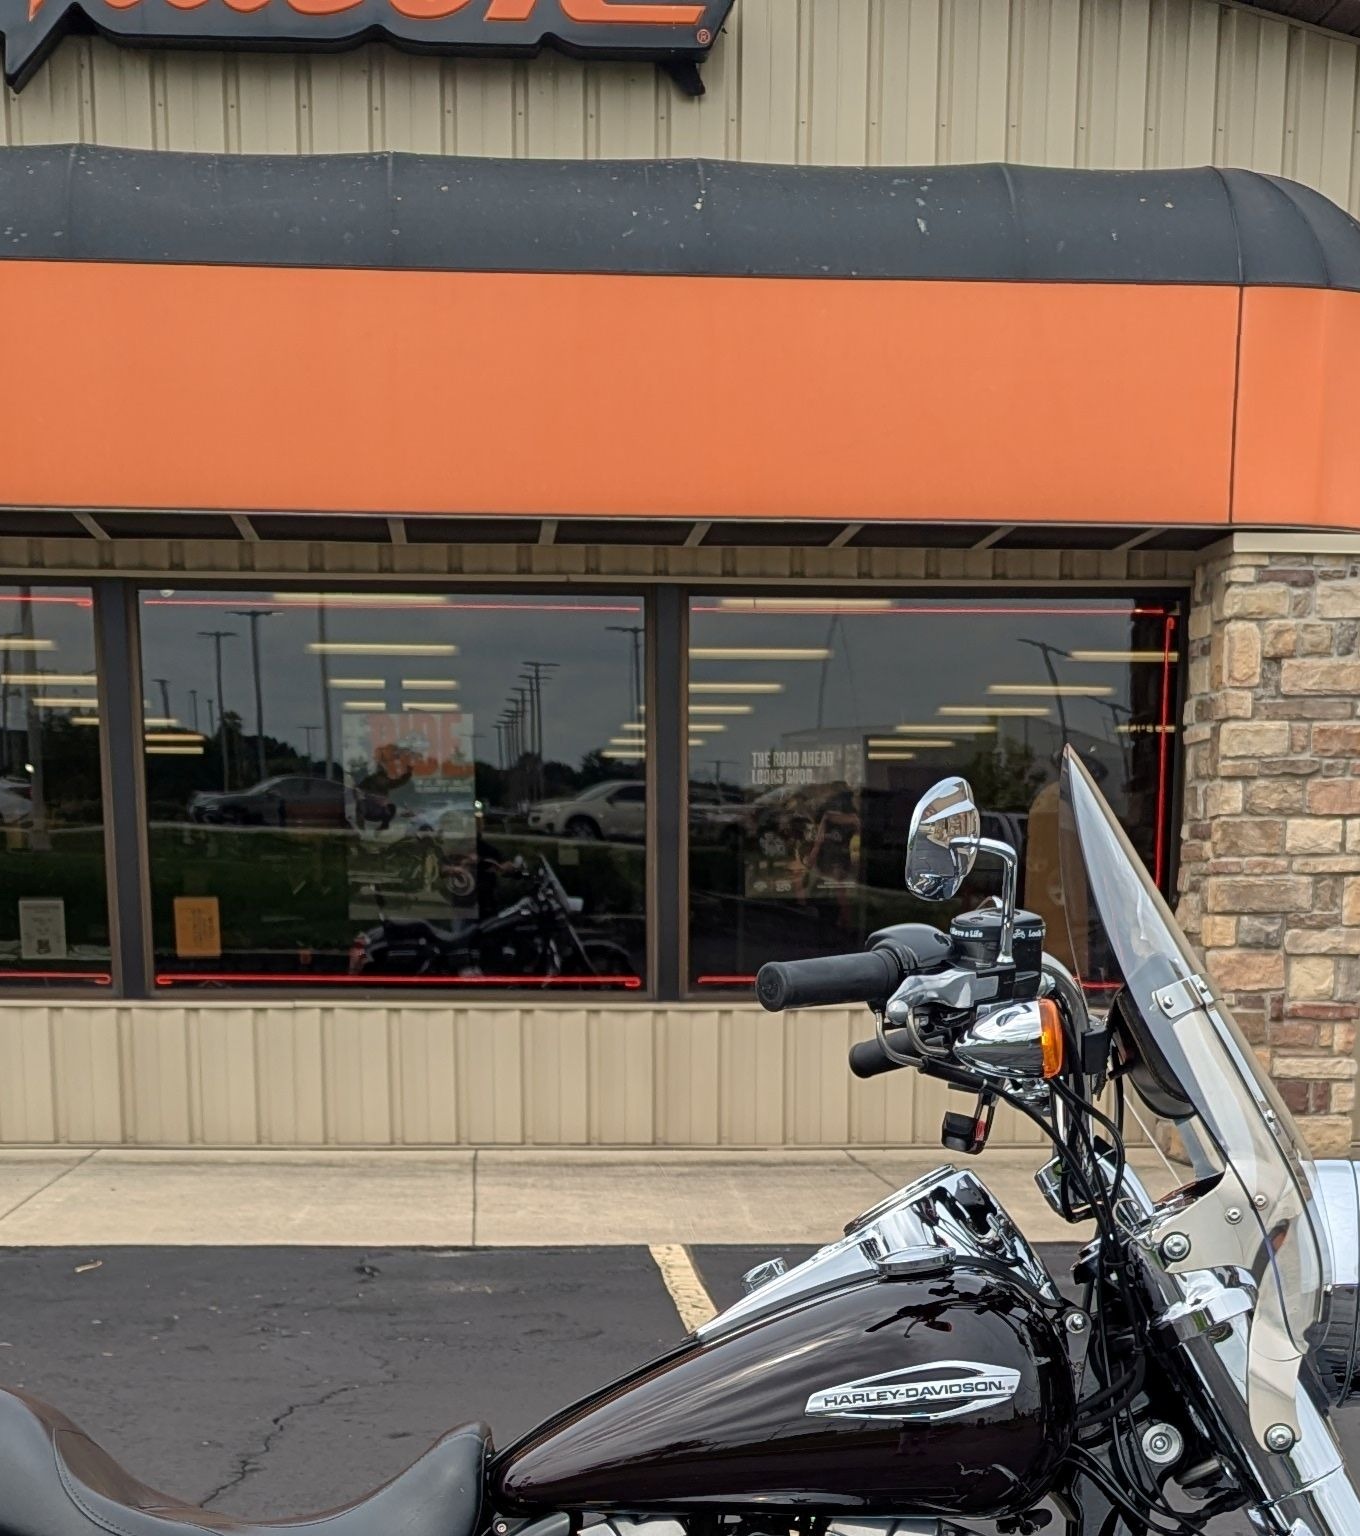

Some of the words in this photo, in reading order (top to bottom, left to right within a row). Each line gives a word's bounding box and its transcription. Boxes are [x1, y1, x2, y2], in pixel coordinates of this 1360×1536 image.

[751, 752, 771, 768] THE
[773, 751, 800, 767] ROAD
[801, 751, 834, 767] AHEAD
[751, 769, 784, 785] LOOKS
[823, 1379, 1004, 1408] HARLEY-DAVIDSON
